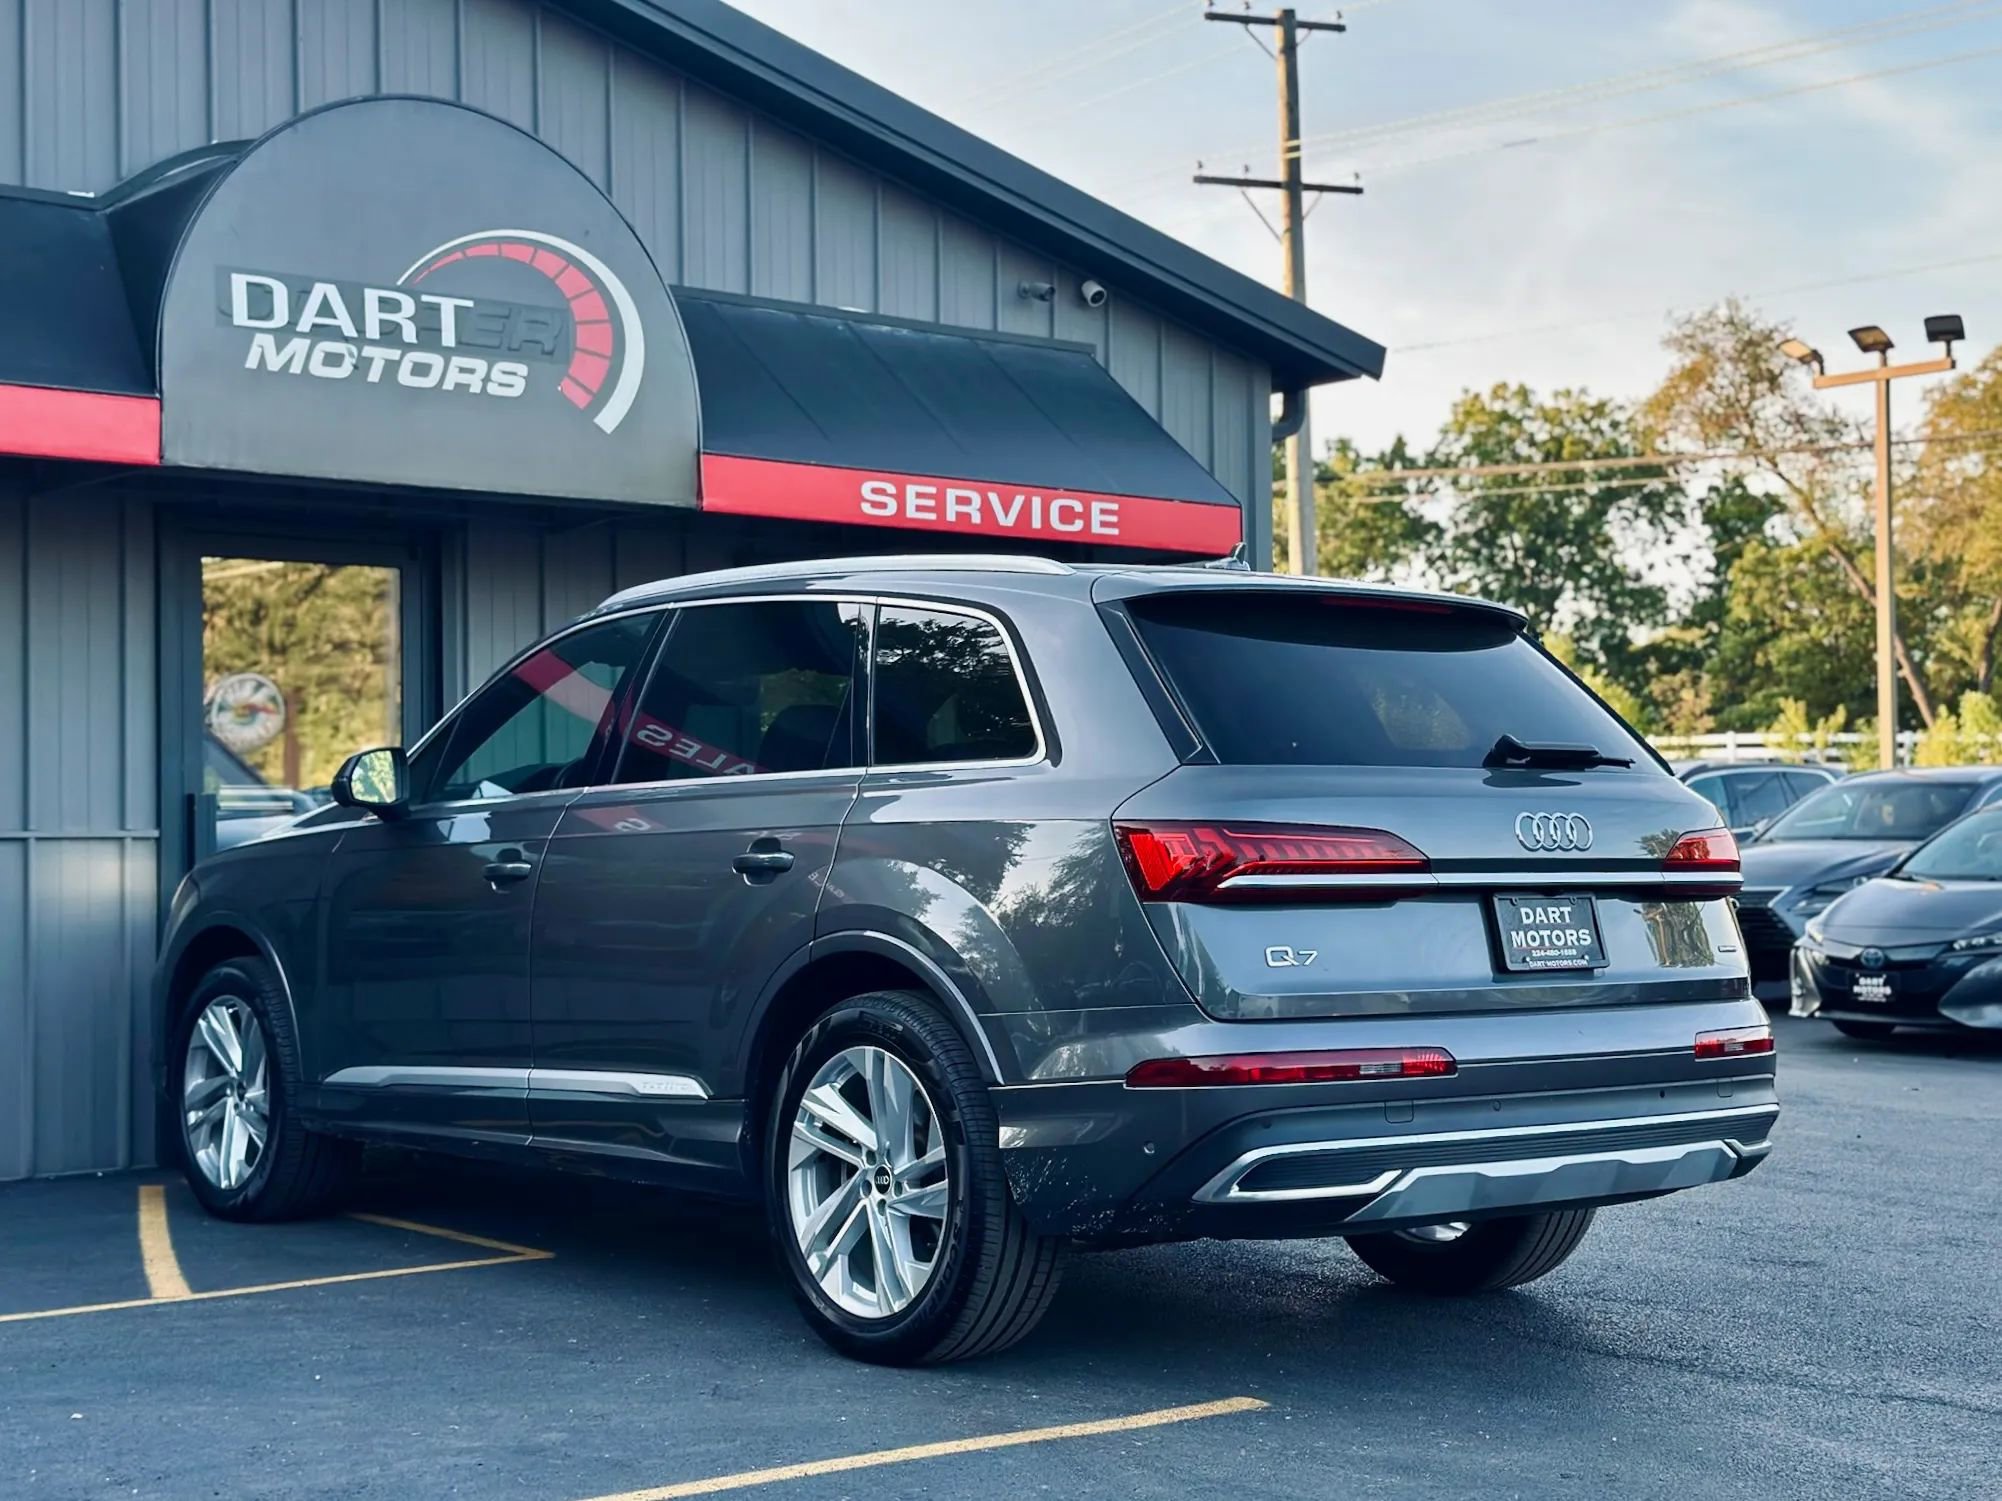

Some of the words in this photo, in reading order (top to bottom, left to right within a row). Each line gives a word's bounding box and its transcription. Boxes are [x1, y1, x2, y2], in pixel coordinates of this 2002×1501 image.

[230, 272, 475, 348] DART
[244, 332, 530, 398] MOTORS
[860, 480, 1120, 536] SERVICE
[1519, 906, 1572, 925] DART
[1264, 945, 1319, 968] Q7
[1510, 928, 1592, 949] MOTORS
